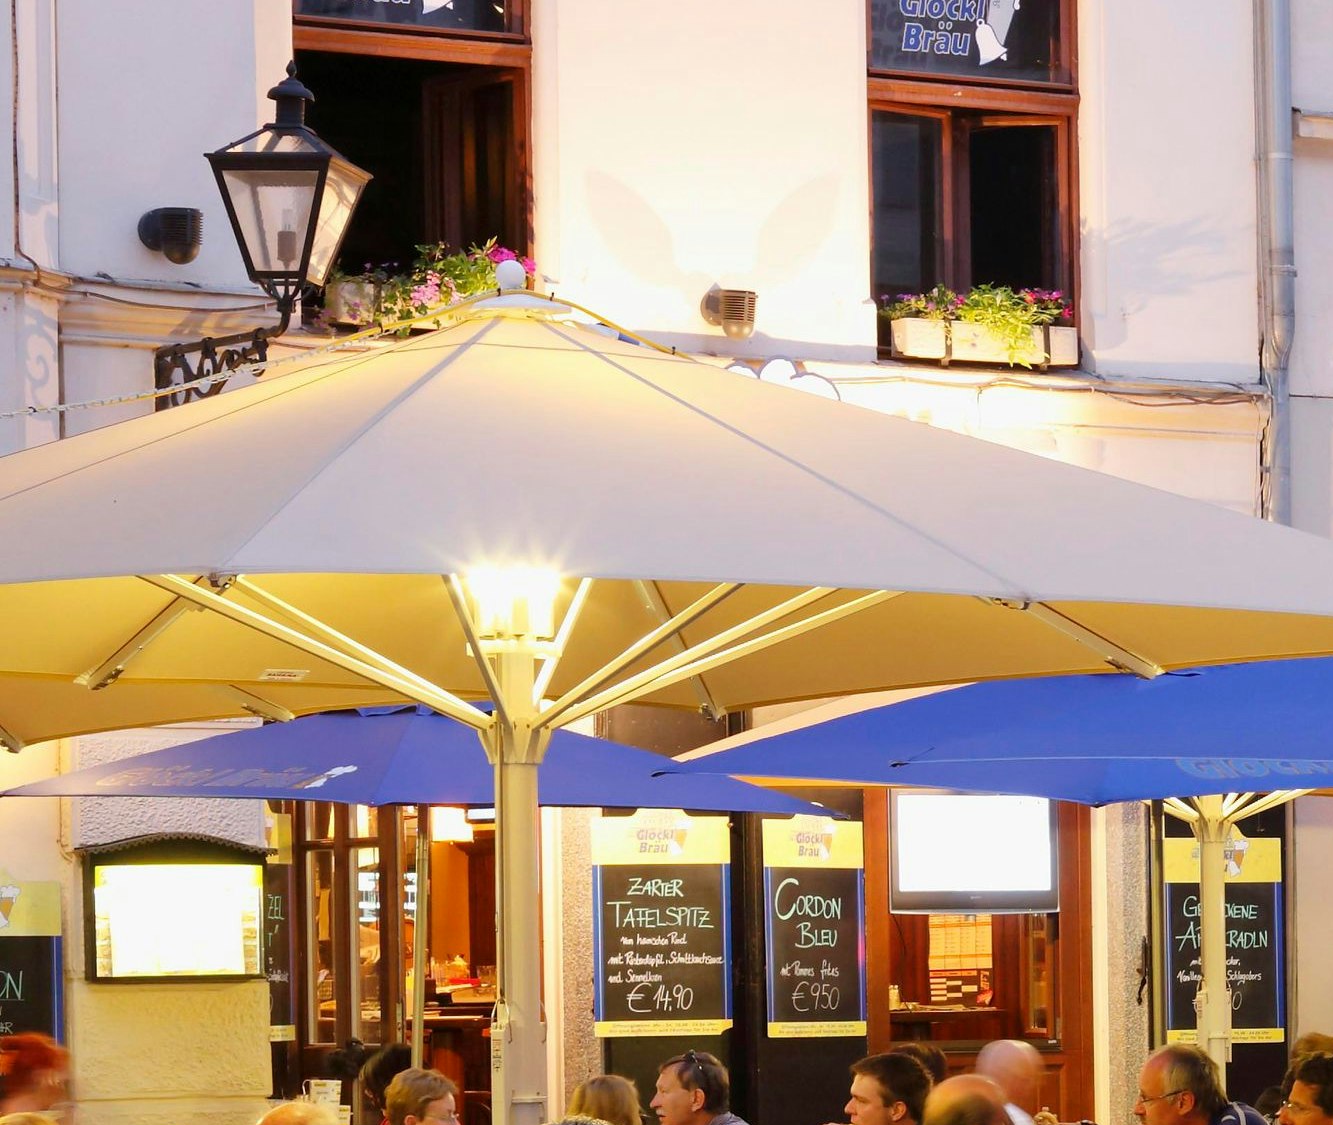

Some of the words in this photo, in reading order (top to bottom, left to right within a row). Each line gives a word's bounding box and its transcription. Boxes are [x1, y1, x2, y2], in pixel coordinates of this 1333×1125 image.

[902, 21, 971, 56] Bräu
[627, 877, 685, 897] ZARTER
[775, 877, 842, 920] CORDON
[606, 901, 715, 929] TAFELSPITZ
[795, 922, 838, 949] BLEU
